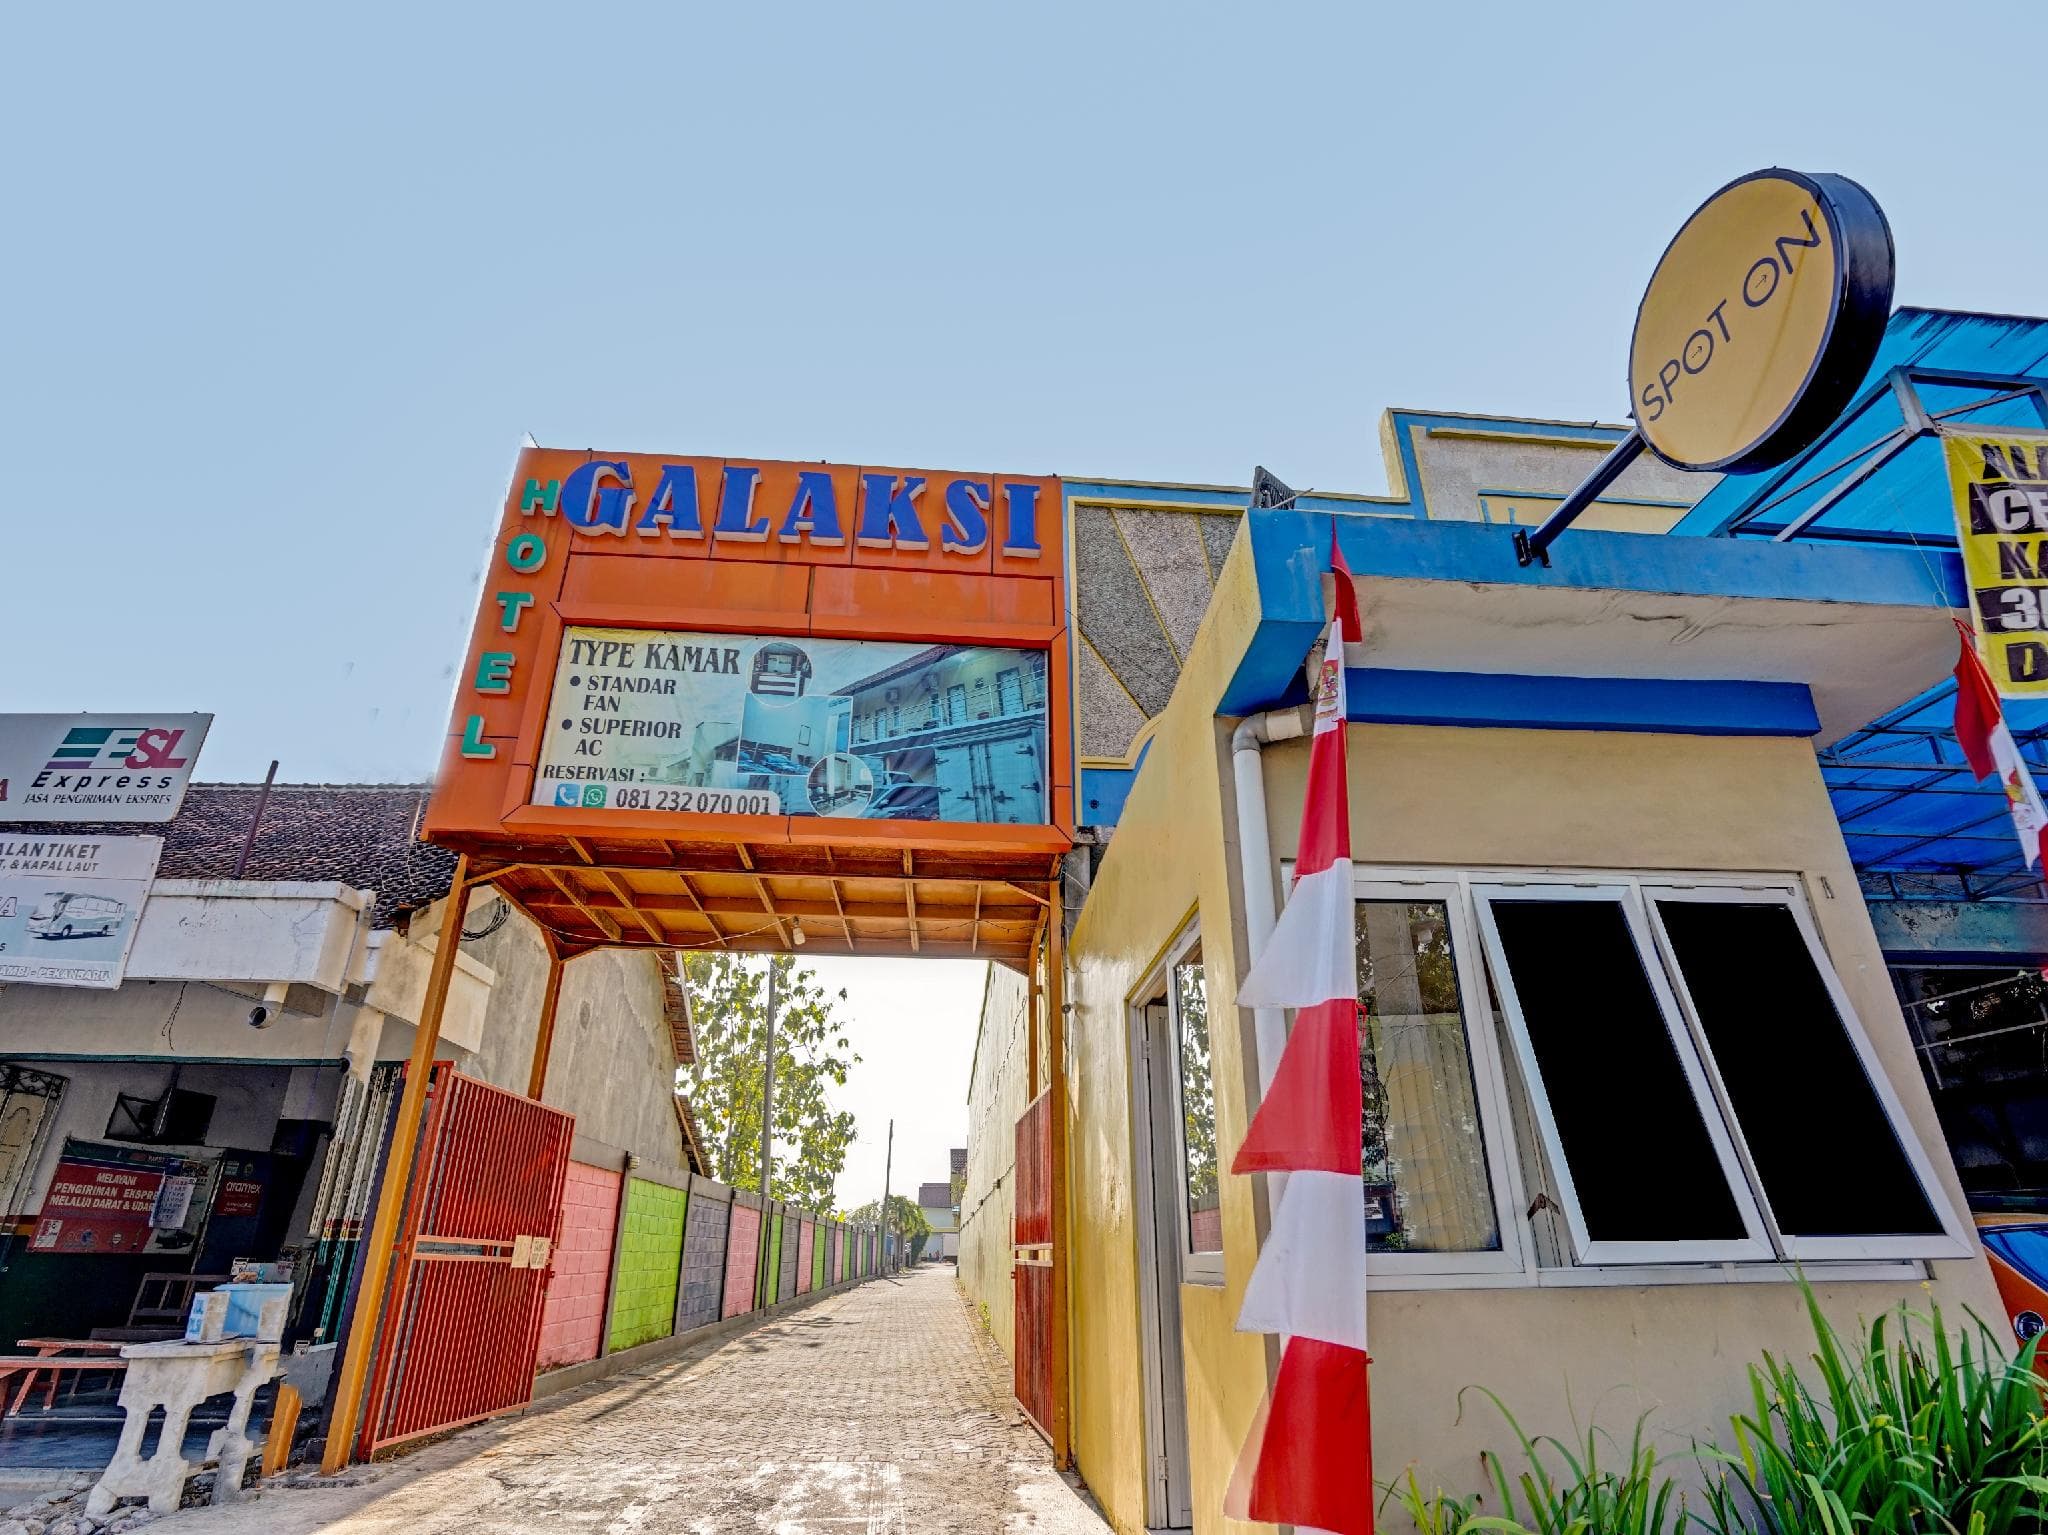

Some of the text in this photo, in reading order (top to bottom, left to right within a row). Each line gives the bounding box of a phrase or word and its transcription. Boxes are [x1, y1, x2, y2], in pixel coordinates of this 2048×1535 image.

[1641, 208, 1822, 422] SPOT ON
[560, 460, 1041, 559] GALAKSI
[461, 478, 562, 760] HOTEL
[570, 638, 740, 674] TYPE KAMAR
[587, 675, 677, 695] STANDAR
[583, 694, 621, 713] FAN
[579, 717, 682, 739] SUPERIOR
[574, 739, 602, 756] AC
[31, 771, 173, 792] Express
[543, 764, 635, 783] RESERVASI
[23, 793, 172, 805] JASA PENGIRIMAN EKSPRES
[615, 788, 771, 816] 081 232 070 001
[47, 844, 101, 859] TIKET
[21, 860, 63, 871] KAPAL
[66, 861, 99, 872] LAUT
[0, 896, 18, 917] A
[54, 1182, 119, 1197] PENGIRIMAN
[226, 1181, 263, 1194] aramex
[49, 1194, 92, 1208] MELALUI
[92, 1198, 123, 1210] DARAT
